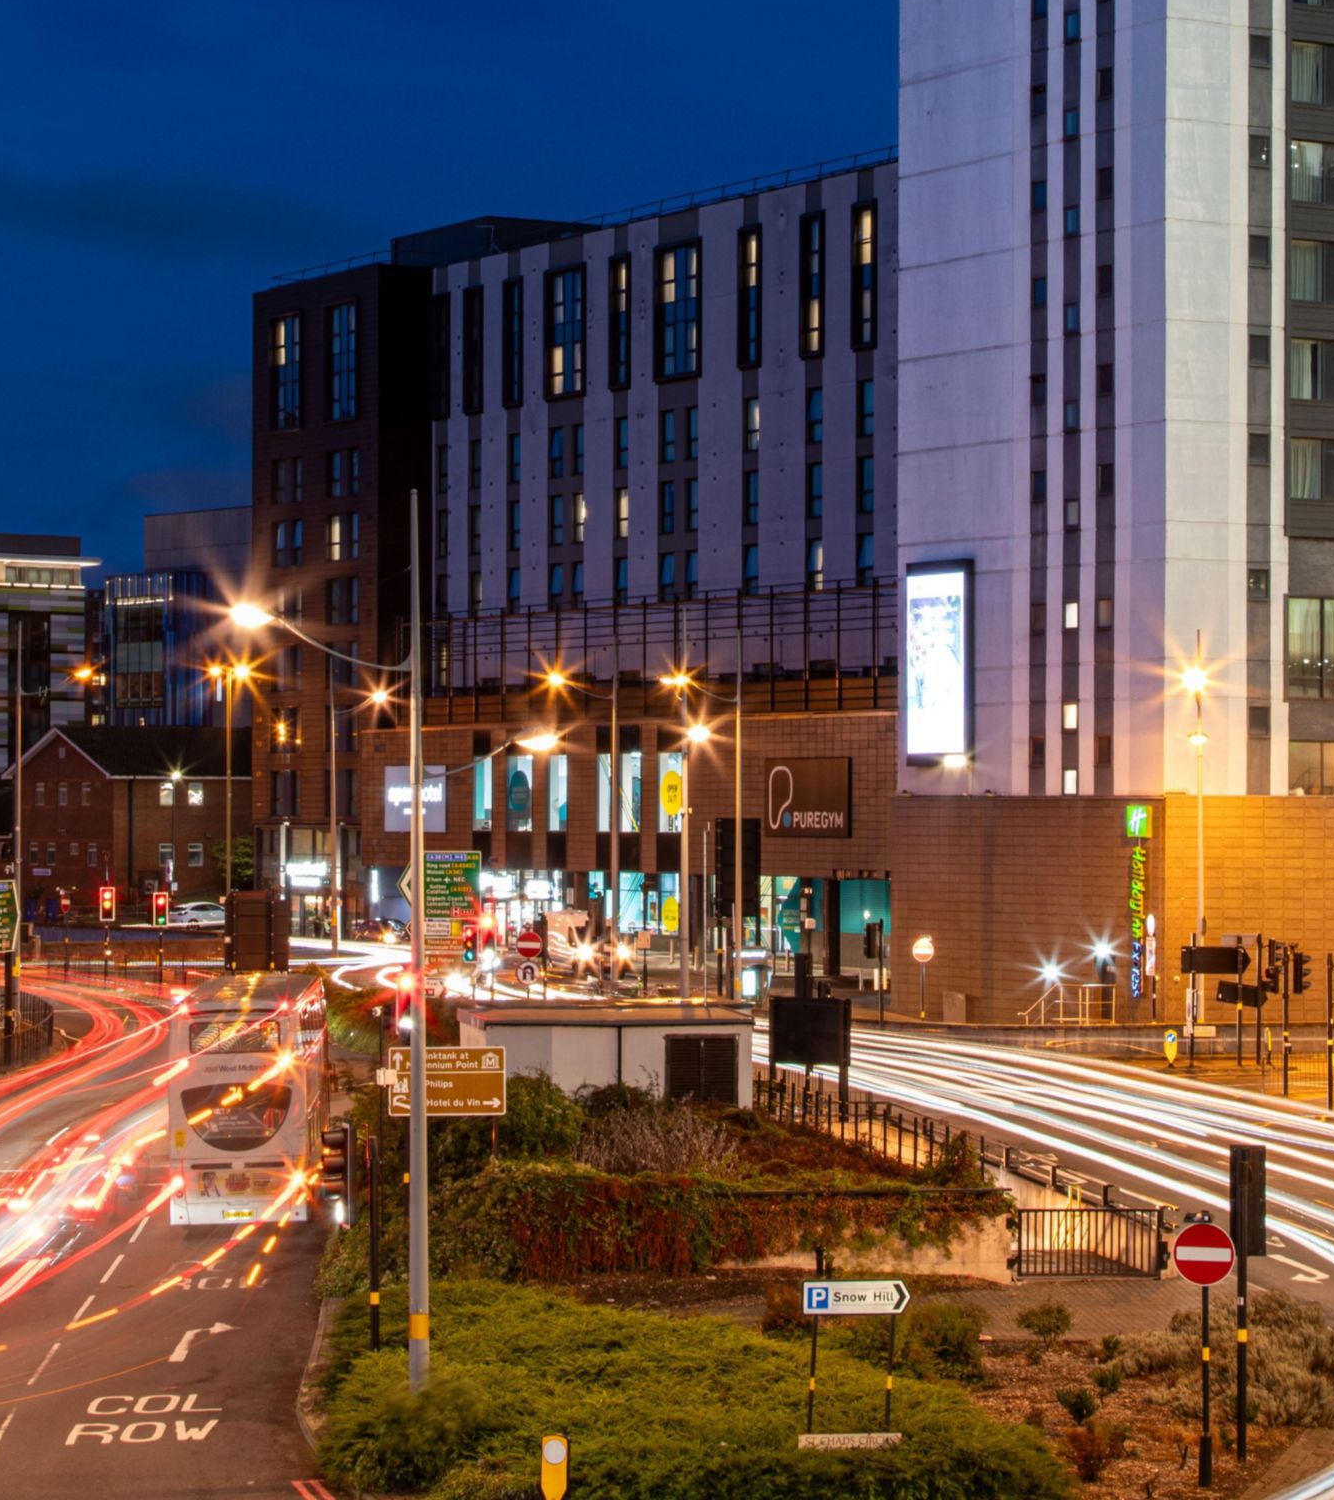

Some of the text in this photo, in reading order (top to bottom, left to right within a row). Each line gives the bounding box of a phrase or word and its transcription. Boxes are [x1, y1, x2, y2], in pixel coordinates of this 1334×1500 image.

[793, 811, 844, 829] PUREGYM
[1129, 846, 1145, 911] Holiday
[1132, 911, 1145, 939] Inn
[425, 1052, 469, 1060] inktank at
[456, 1060, 478, 1069] Point
[425, 1080, 454, 1090] Philips
[427, 1099, 481, 1107] Hotel du Vin
[833, 1292, 867, 1302] Snow
[873, 1292, 894, 1302] Hill
[87, 1393, 223, 1415] COL
[65, 1419, 220, 1446] ROW
[820, 1436, 855, 1445] CHADS
